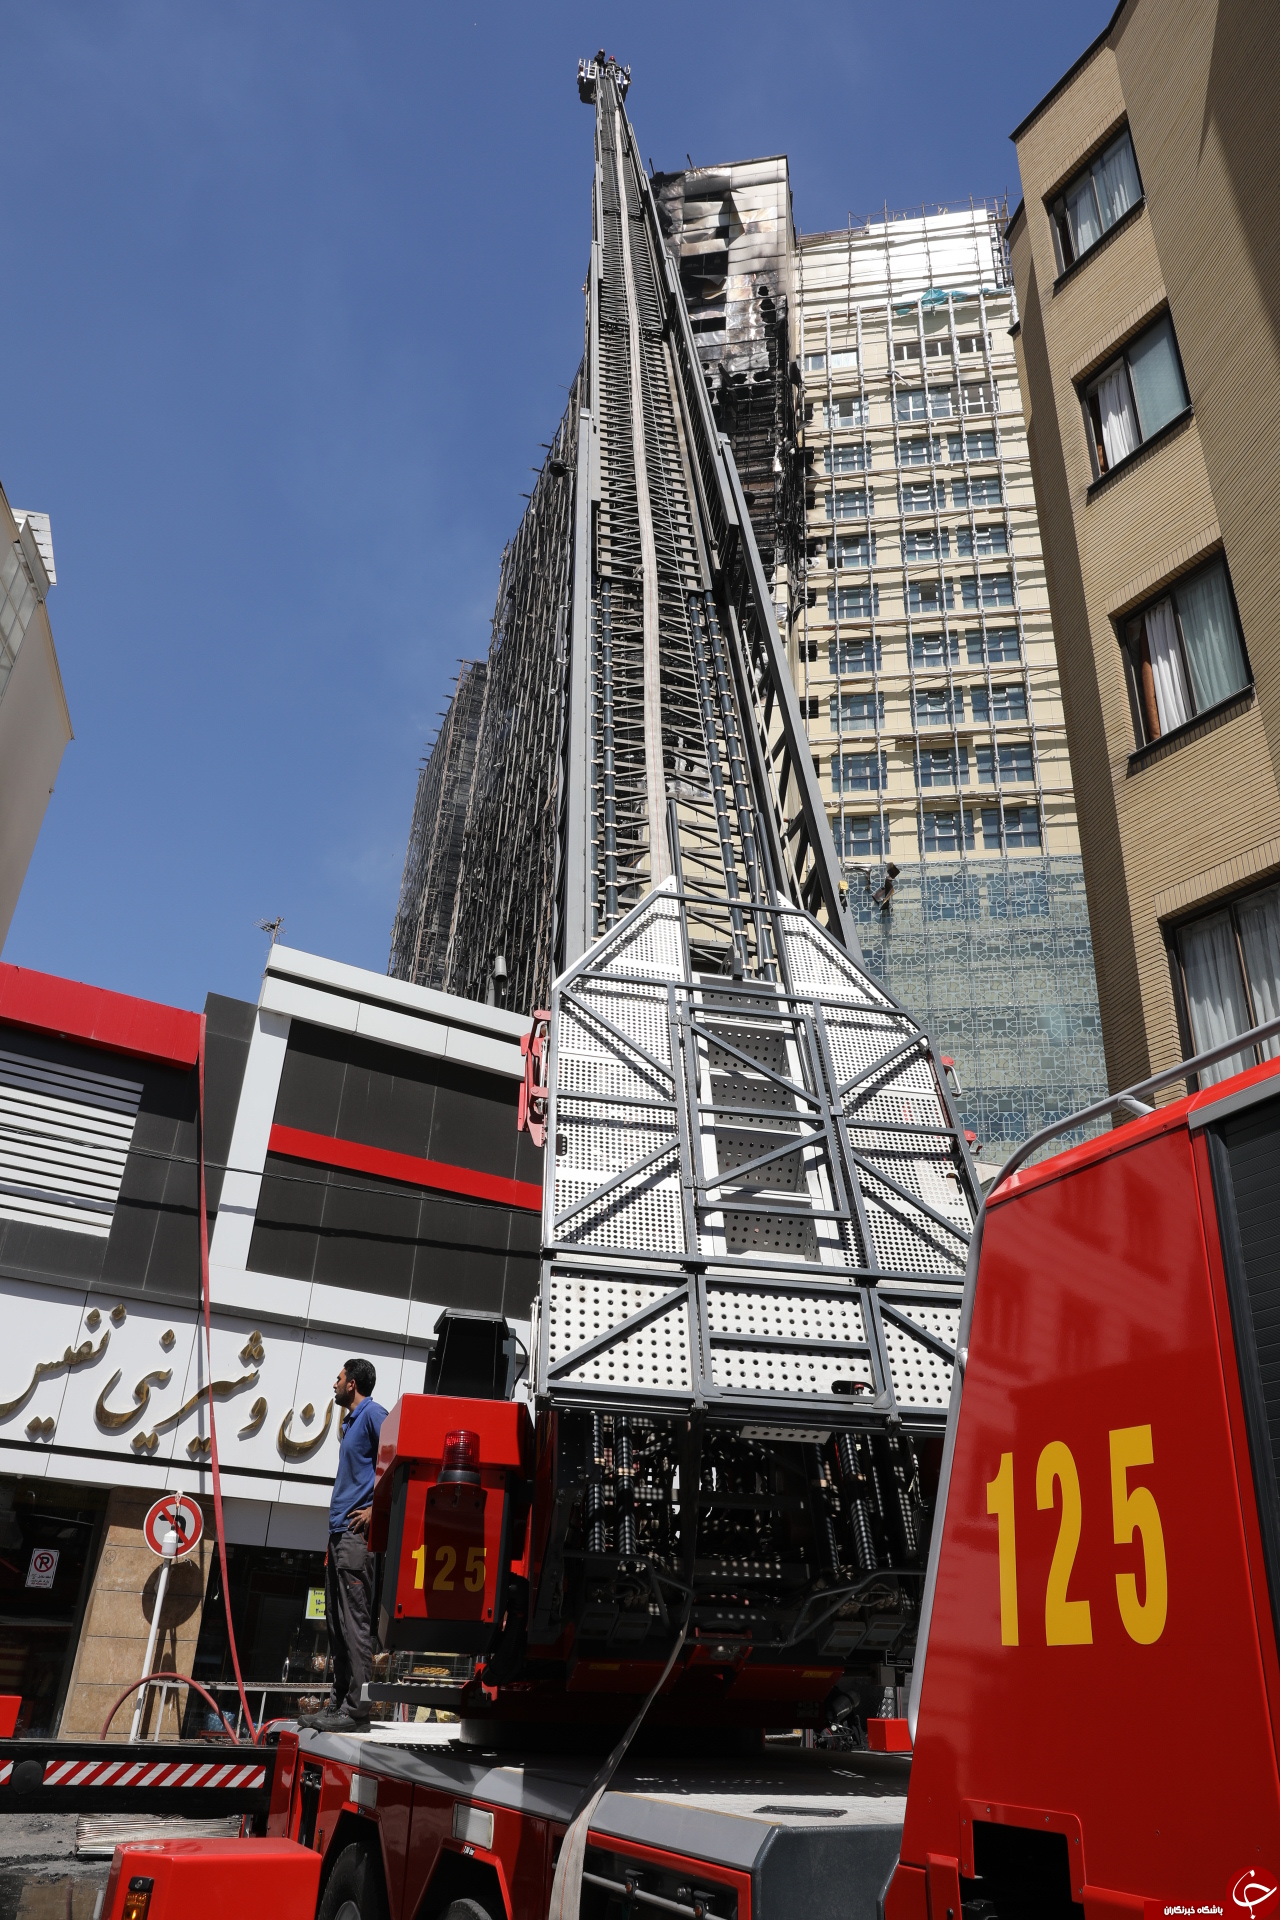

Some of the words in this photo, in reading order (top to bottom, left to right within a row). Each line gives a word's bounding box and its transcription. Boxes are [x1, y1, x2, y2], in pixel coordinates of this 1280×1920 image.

[95, 1329, 265, 1453] شیرینی
[239, 1397, 267, 1432] و
[411, 1544, 487, 1592] 125
[987, 1424, 1168, 1646] 125
